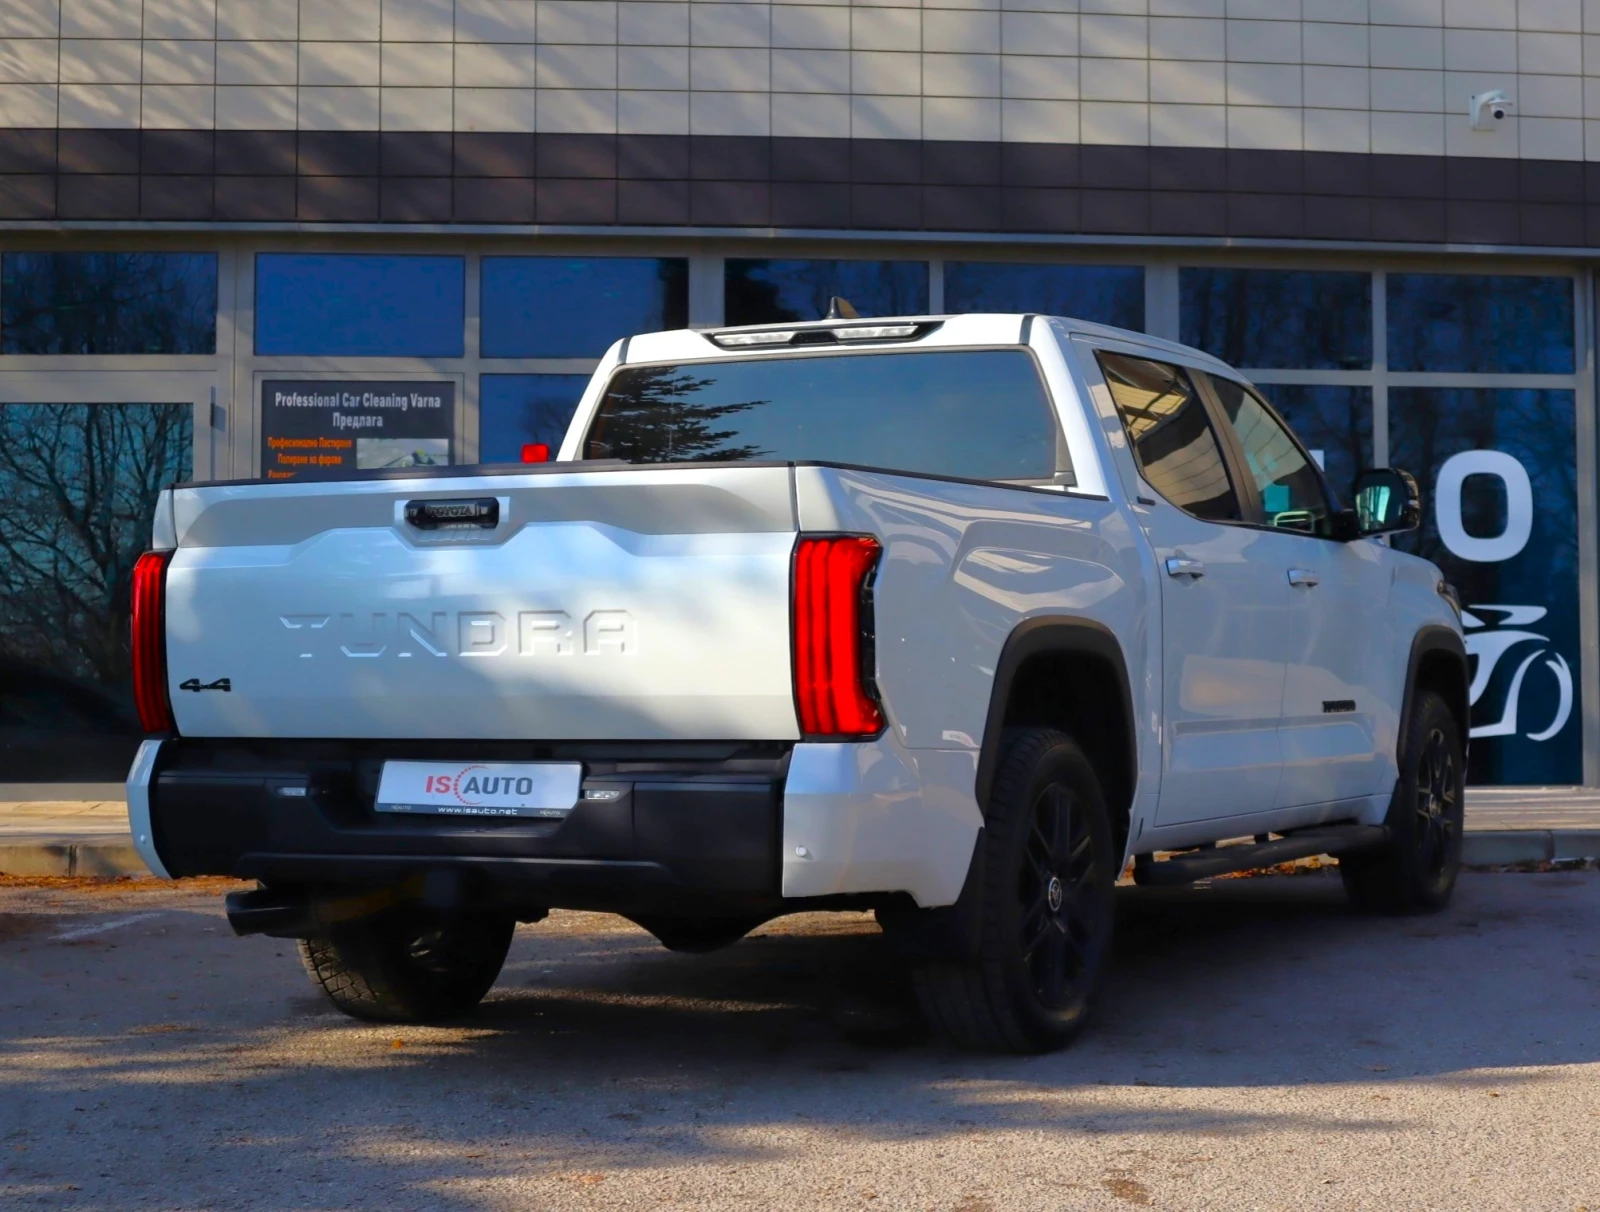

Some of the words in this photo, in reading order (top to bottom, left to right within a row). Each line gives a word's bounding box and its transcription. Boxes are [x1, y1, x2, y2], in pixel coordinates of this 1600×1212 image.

[275, 392, 340, 408] Professional
[342, 392, 360, 408] Car
[362, 393, 408, 411] Cleaning
[410, 393, 441, 408] Varna
[332, 412, 383, 430] Предлага
[425, 504, 473, 518] TOYOTA
[279, 609, 638, 657] TUNDRA
[438, 806, 518, 815] www.isauto.net
